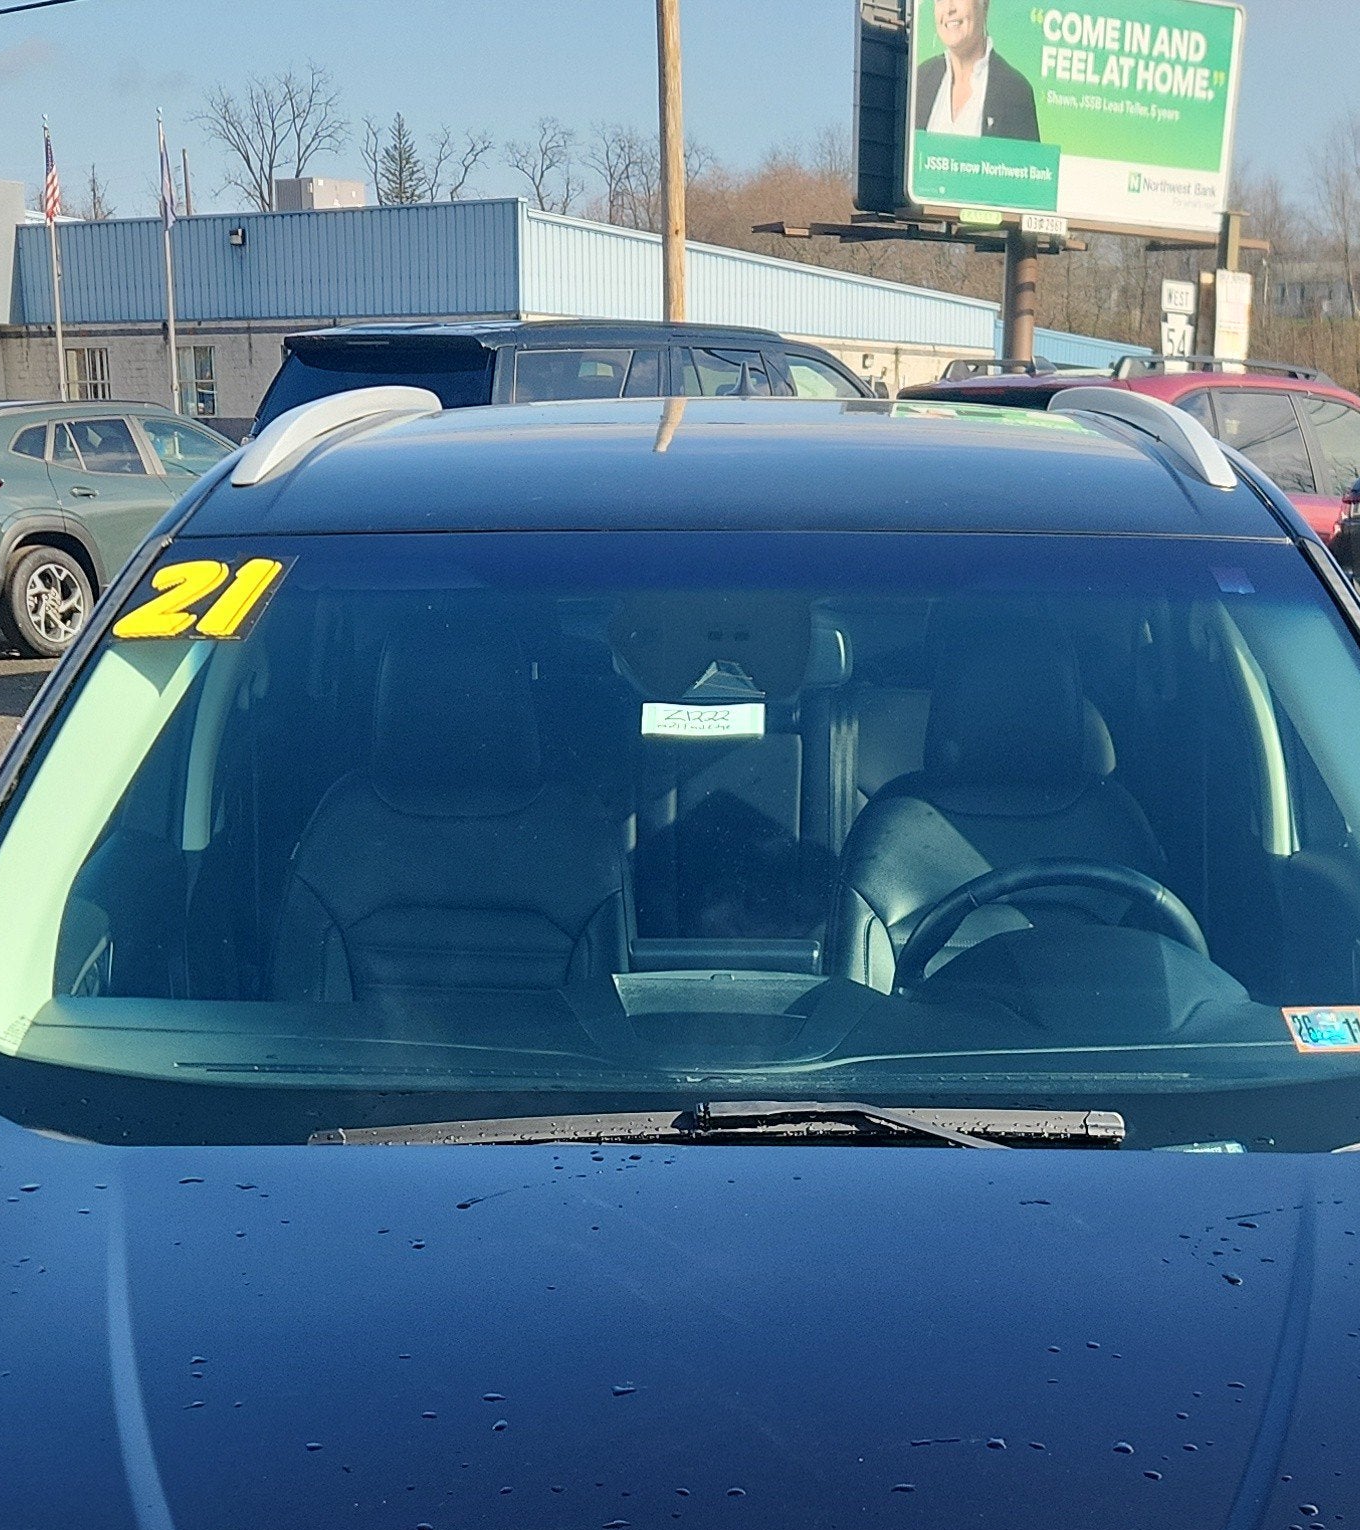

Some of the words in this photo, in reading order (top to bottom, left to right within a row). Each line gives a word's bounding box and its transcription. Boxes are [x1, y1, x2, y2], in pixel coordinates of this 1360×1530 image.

[1124, 20, 1151, 54] IN
[1152, 26, 1207, 62] AND
[1041, 45, 1101, 86] FEEL
[1101, 55, 1135, 89] AT
[925, 156, 949, 171] JSSB
[950, 159, 959, 172] is
[960, 162, 981, 174] now
[981, 160, 1029, 179] Northwest
[1029, 165, 1052, 180] Bank
[1142, 177, 1191, 194] Northwest
[1194, 182, 1216, 197] Bank
[1166, 287, 1190, 306] WEST
[1166, 328, 1187, 357] 54
[112, 558, 283, 639] 21
